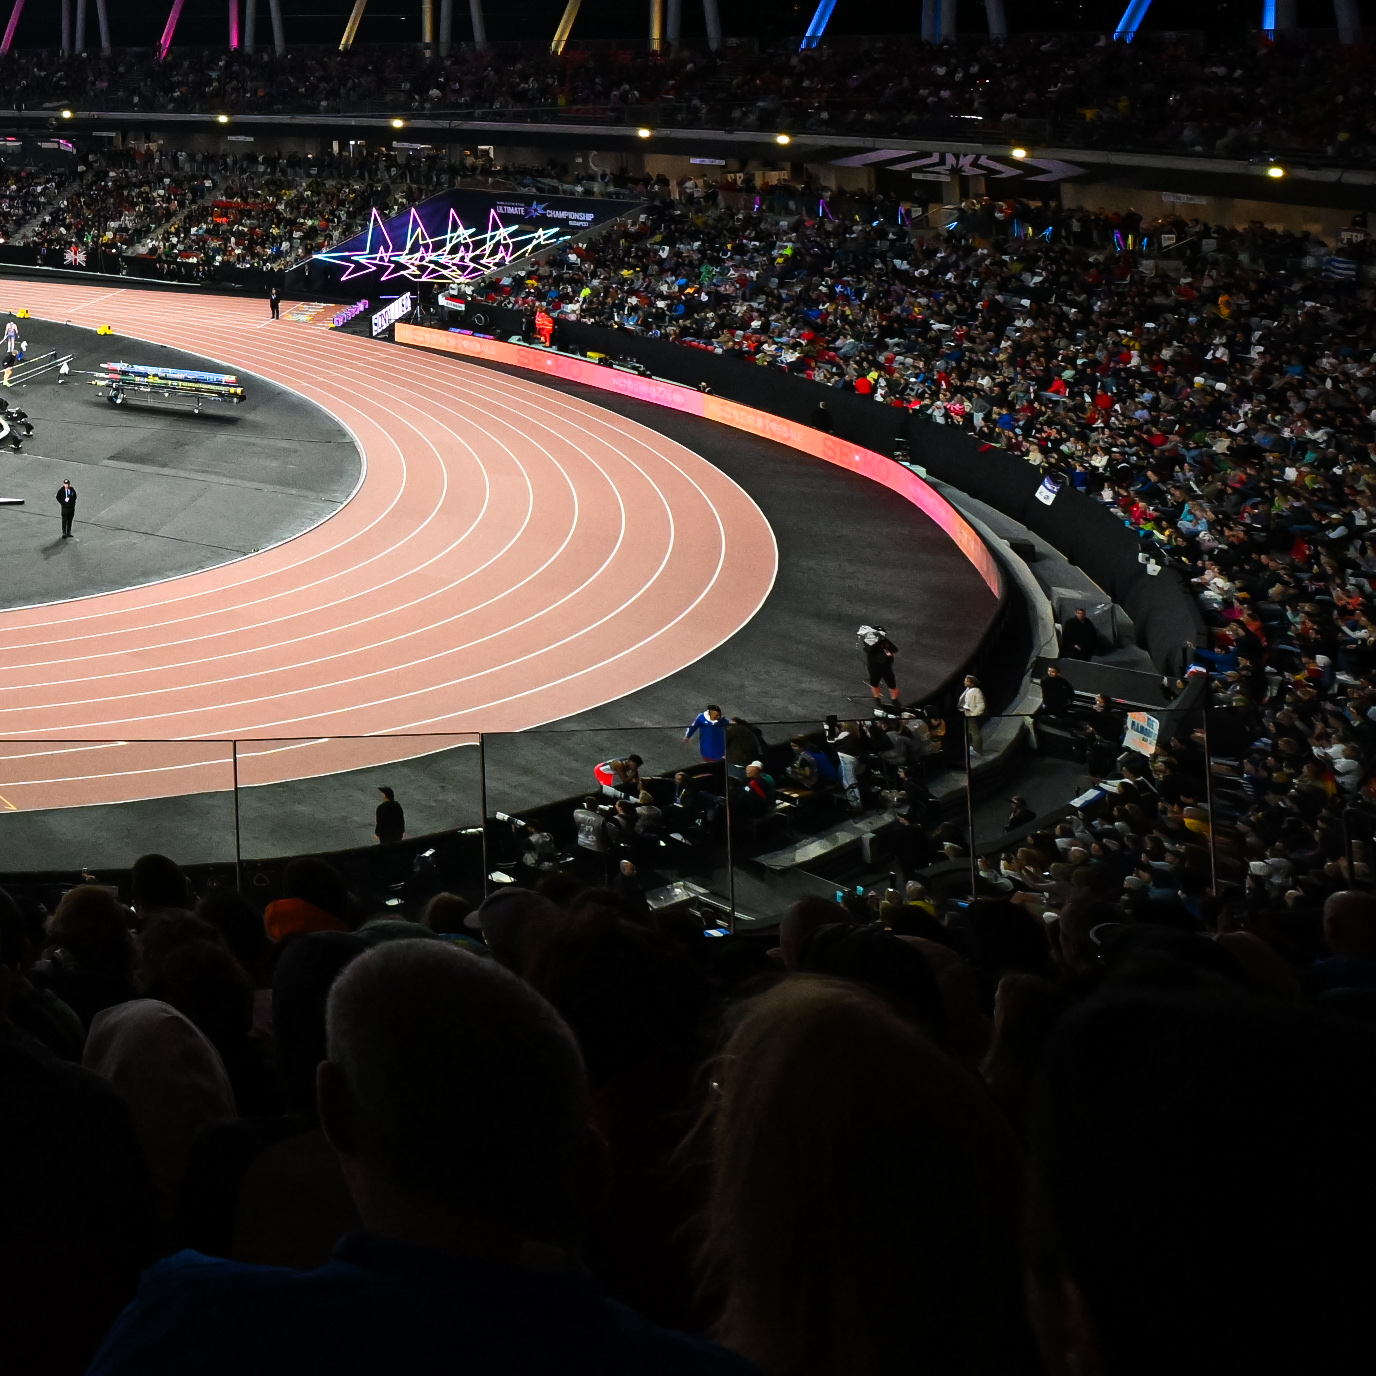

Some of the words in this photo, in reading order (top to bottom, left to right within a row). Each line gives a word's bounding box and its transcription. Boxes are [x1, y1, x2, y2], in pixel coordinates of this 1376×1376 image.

[496, 206, 525, 215] ULTIMATE
[546, 210, 594, 221] CHAMPIONSHIP
[517, 348, 582, 379] SEIKO
[822, 438, 890, 482] SEIKO
